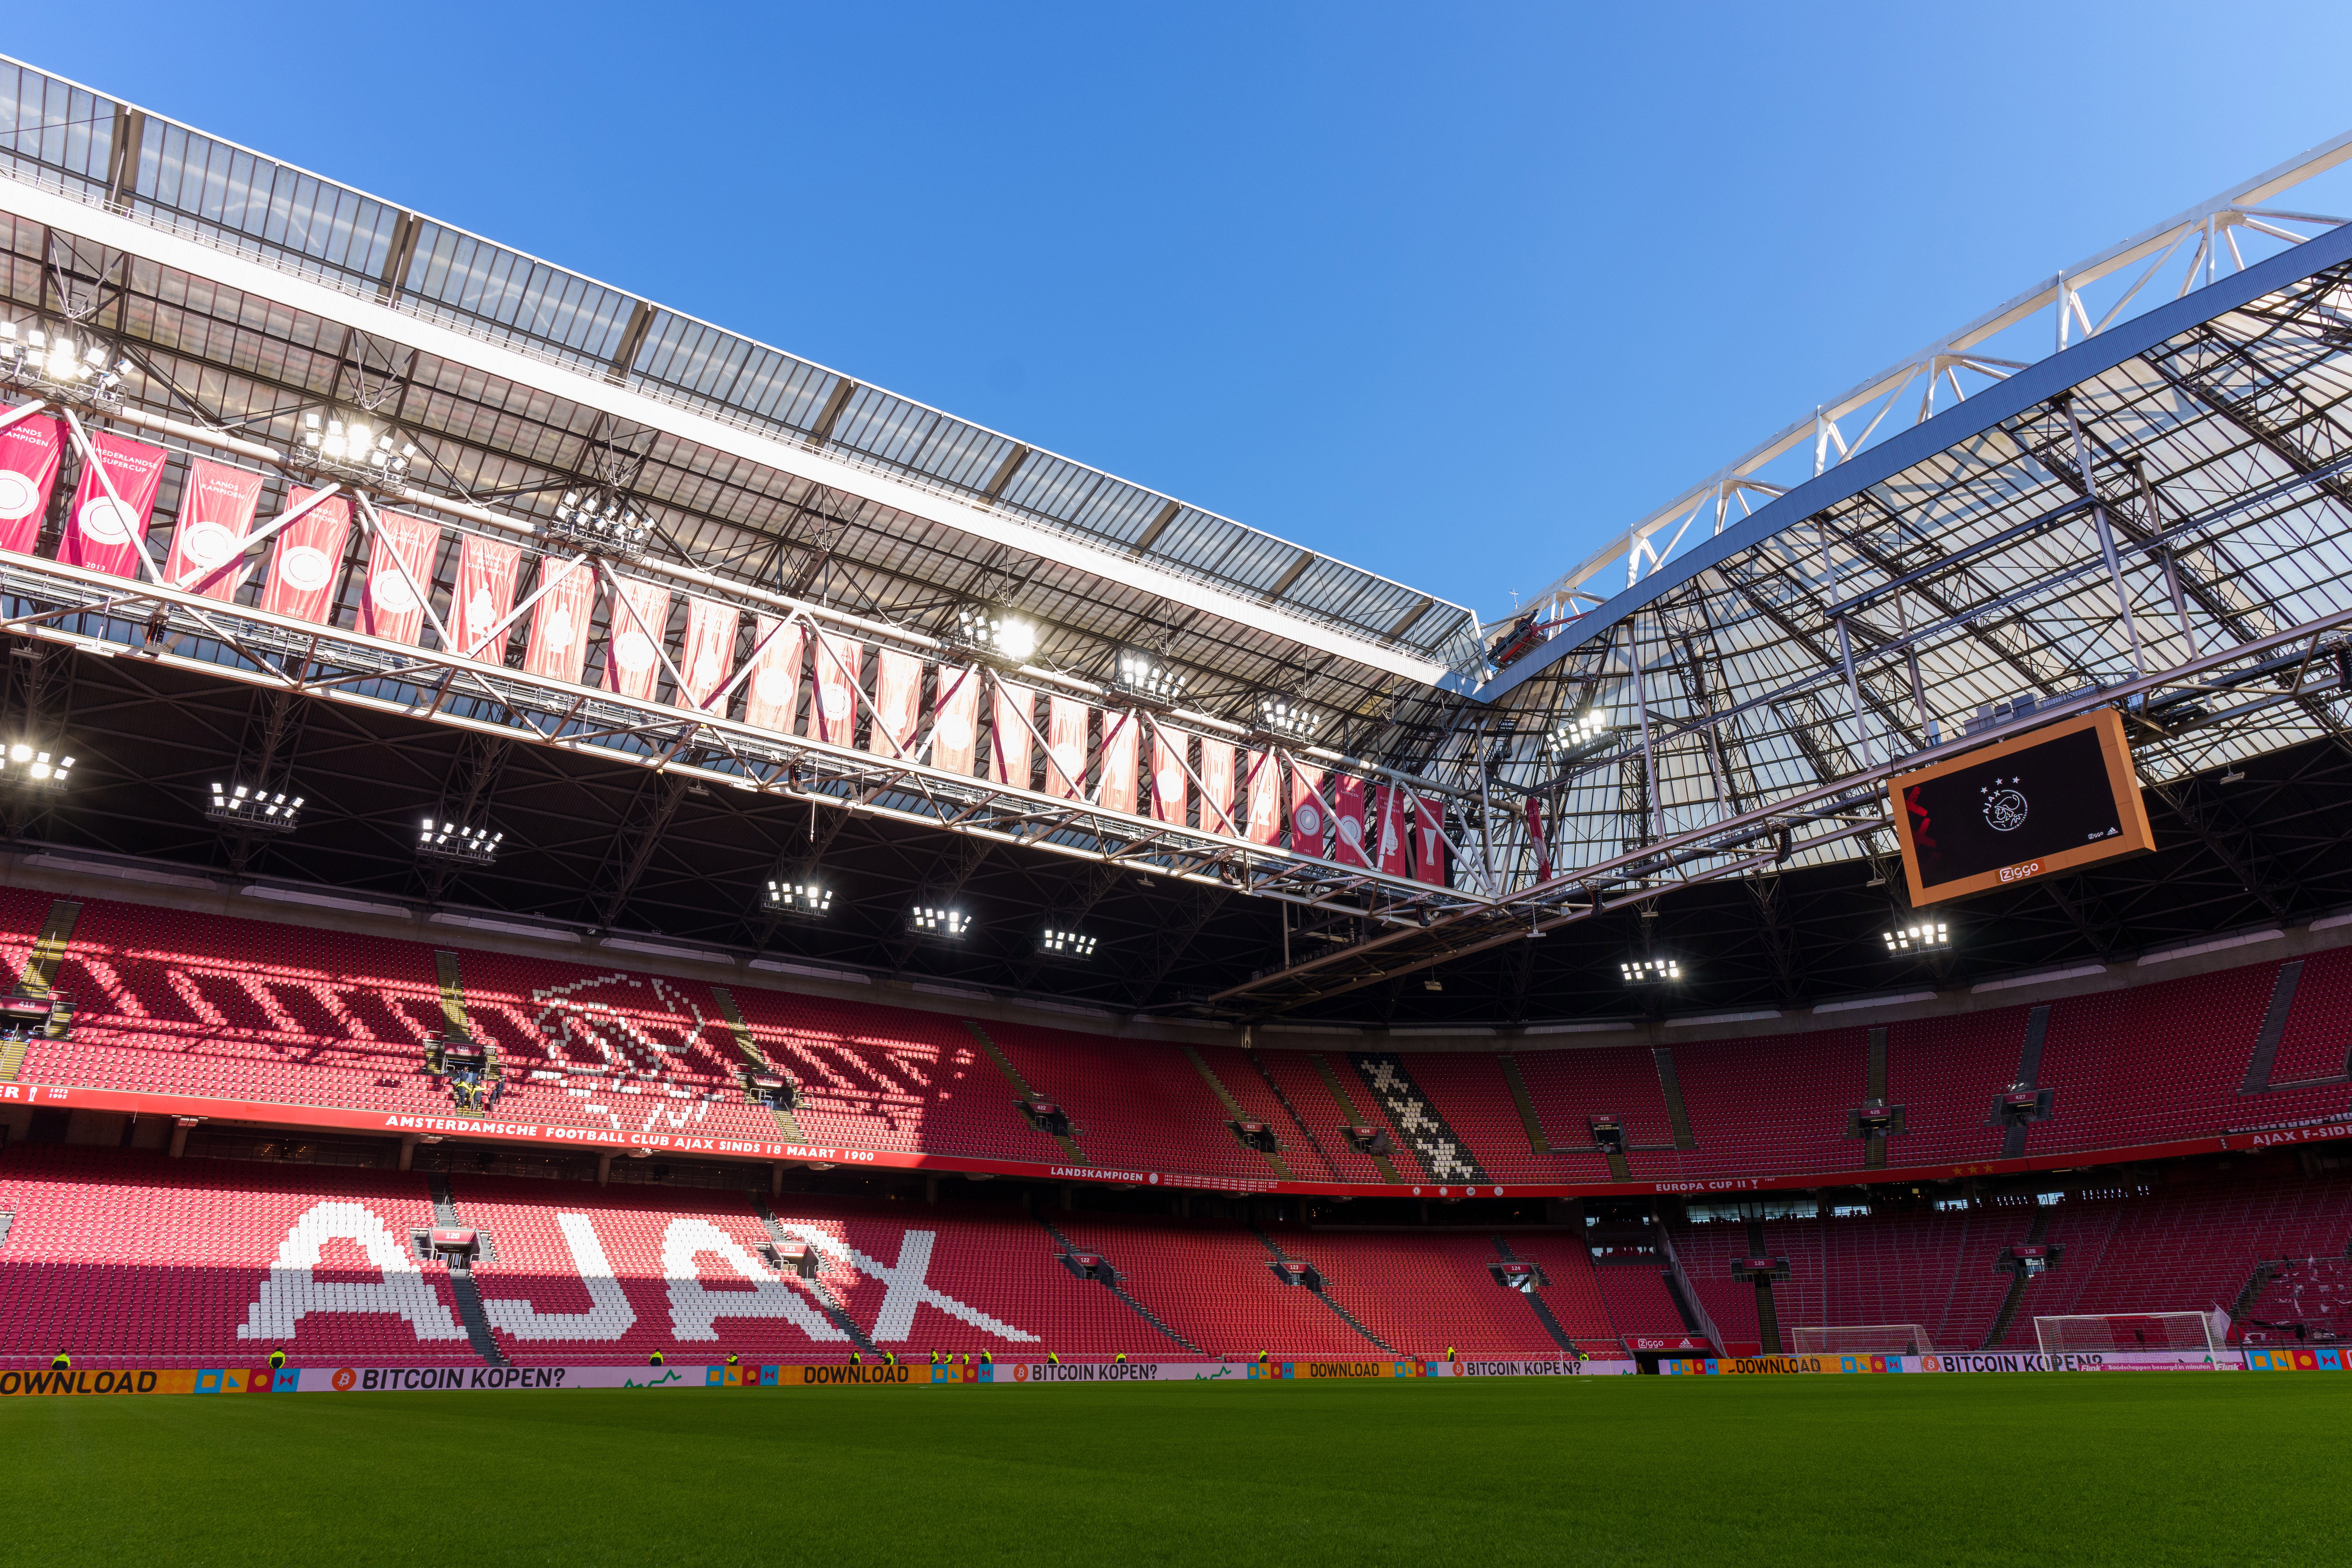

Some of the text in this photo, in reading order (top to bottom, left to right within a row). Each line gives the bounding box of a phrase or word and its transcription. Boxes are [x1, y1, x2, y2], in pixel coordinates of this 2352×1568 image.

[0, 430, 49, 447] KAMPIOEN
[12, 425, 42, 437] LANDS
[95, 448, 158, 470] NEDERLANDSE
[102, 457, 147, 473] SUPERCUP
[201, 483, 245, 499] KAMPIOEN
[211, 479, 239, 491] LANDS
[302, 511, 338, 524] AMPIOEN
[311, 505, 333, 516] ANDS
[86, 561, 105, 572] 2013
[189, 585, 207, 594] 2013
[286, 607, 304, 616] 2012
[379, 629, 395, 637] 2011
[1340, 789, 1359, 798] KAMPIOEN
[1380, 796, 1399, 804] NATIALE
[1983, 790, 2000, 814] AJAX
[385, 1116, 874, 1161] AMSTERDAMSCHE FOOTBALL CLUB AJAX SINDS 18 MAART 1900
[2253, 1125, 2352, 1145] AJAX F-SIDE
[1051, 1167, 1143, 1181] LANDSKAMPIOEN
[1656, 1182, 1704, 1191] EUROPA
[1709, 1181, 1733, 1189] CUP
[237, 1202, 1042, 1344] AJAX
[1310, 1363, 1379, 1377] DOWNLOAD
[1467, 1361, 1581, 1376] BITCOIN KOPEN?
[1736, 1359, 1821, 1374] DOWNLOAD
[1943, 1356, 2020, 1372] BITCOIN
[362, 1368, 566, 1390] BITCOIN KOPEN?
[804, 1365, 909, 1384] DOWNLOAD
[1033, 1364, 1157, 1381] BITCOIN KOPEN?
